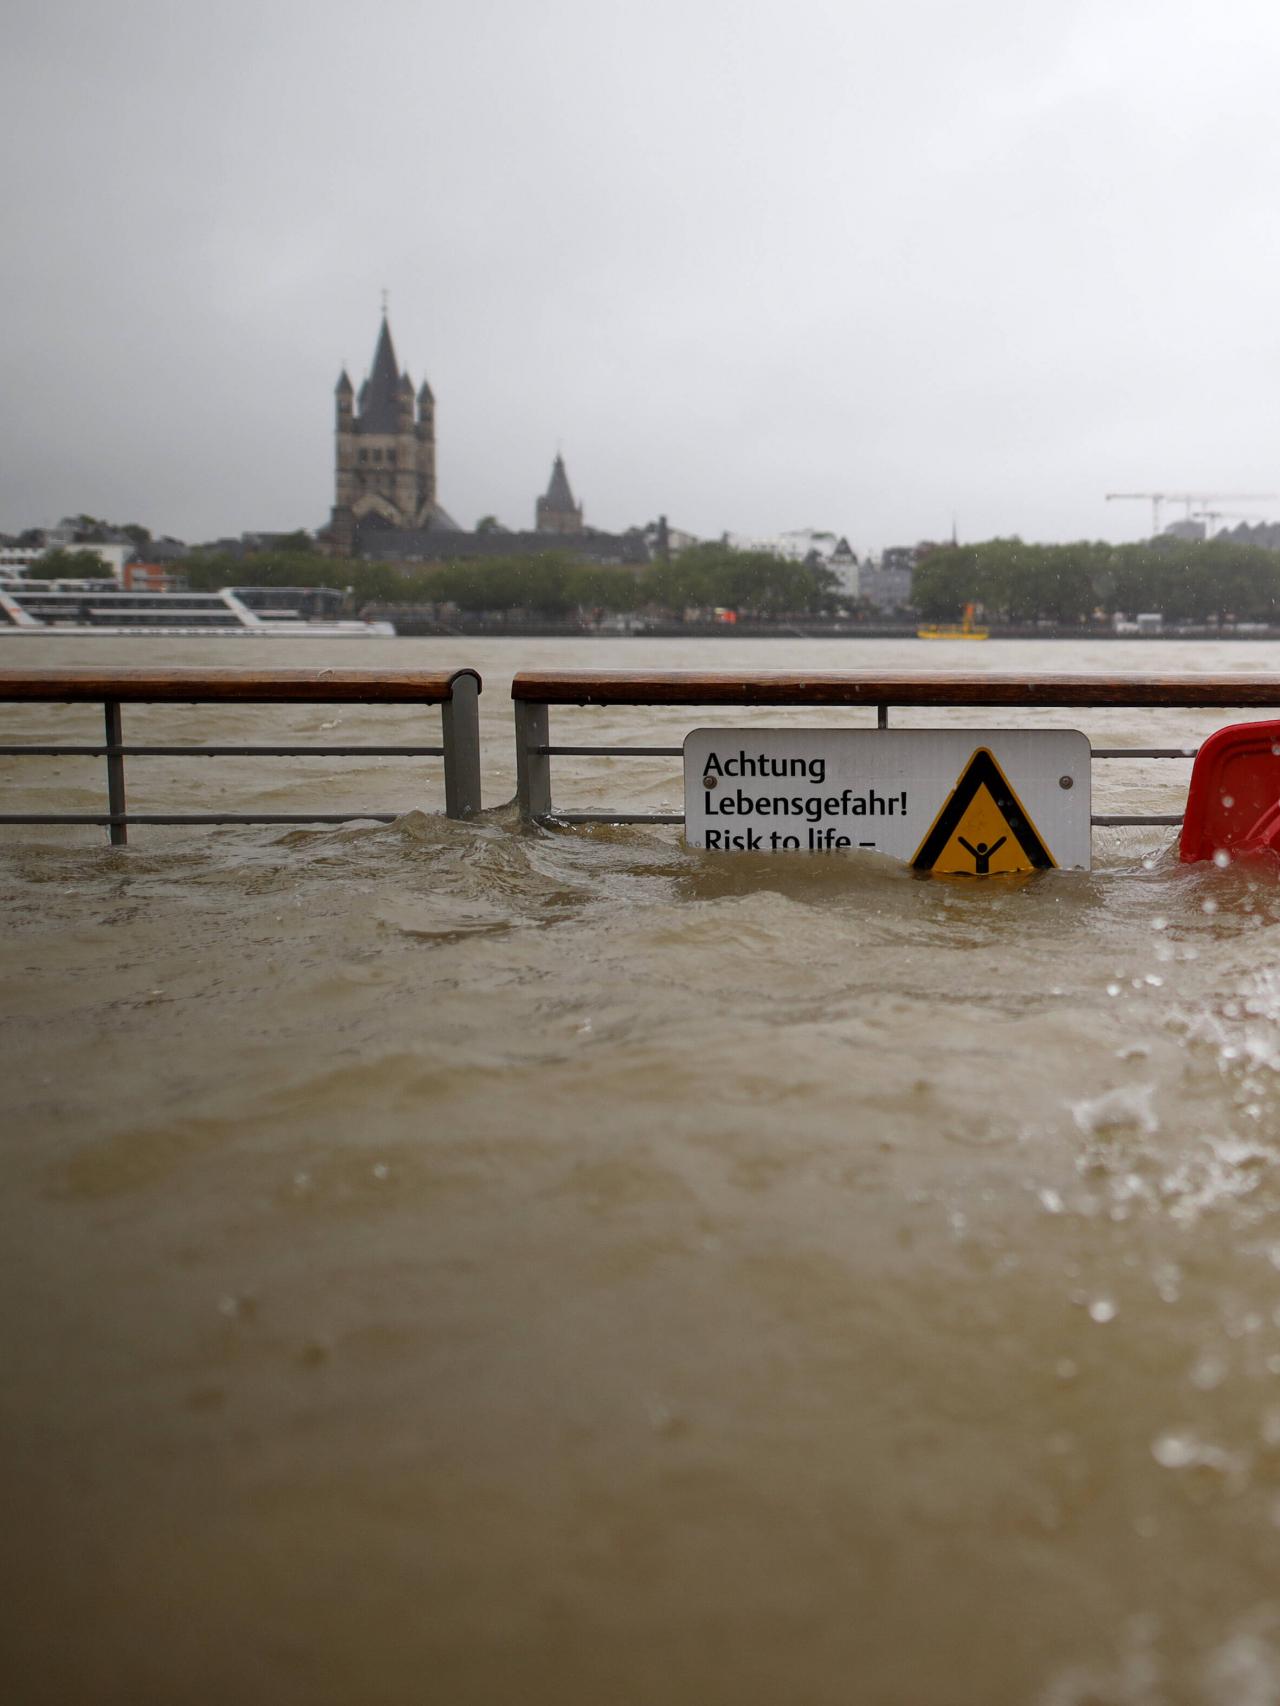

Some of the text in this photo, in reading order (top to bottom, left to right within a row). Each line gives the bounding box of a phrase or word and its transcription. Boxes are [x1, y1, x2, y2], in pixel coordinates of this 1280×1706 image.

[702, 750, 826, 784] Achtung
[704, 789, 908, 822] Lebensgefahr!
[705, 828, 763, 850] Risk
[770, 831, 800, 850] to
[808, 828, 851, 849] life
